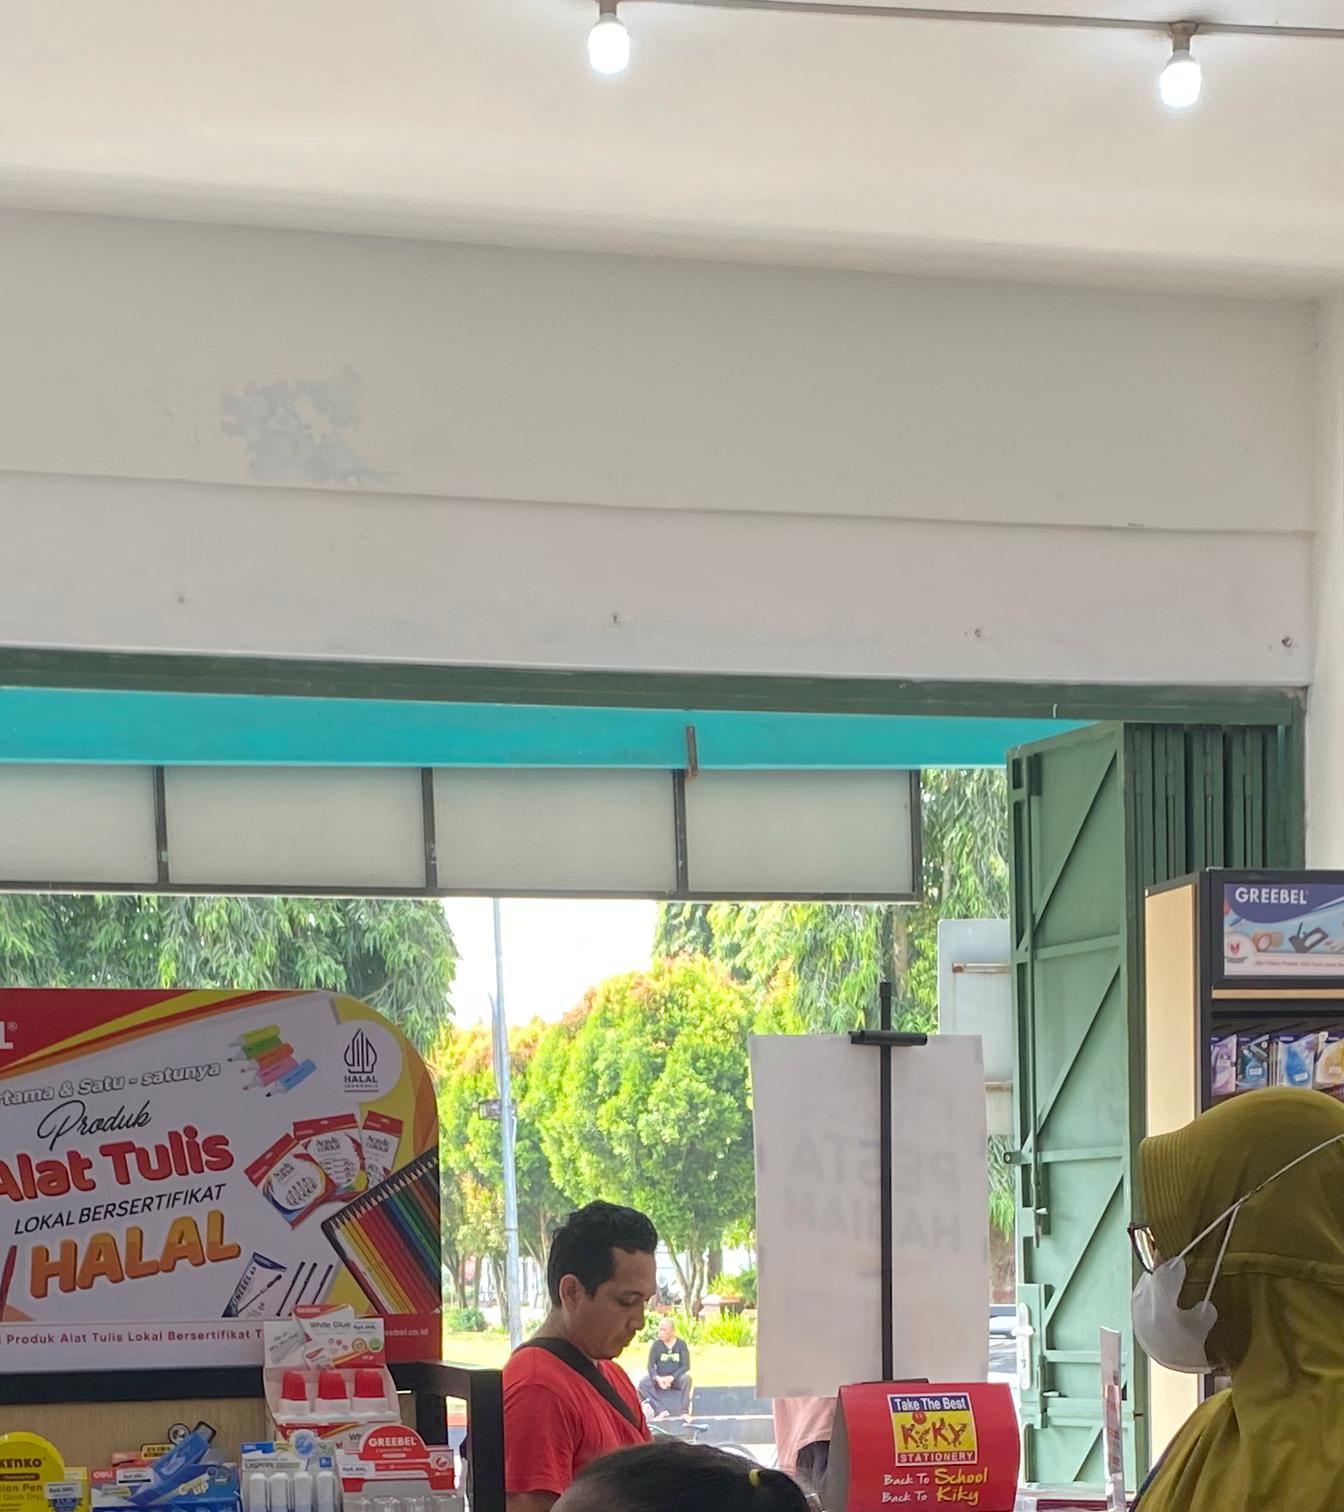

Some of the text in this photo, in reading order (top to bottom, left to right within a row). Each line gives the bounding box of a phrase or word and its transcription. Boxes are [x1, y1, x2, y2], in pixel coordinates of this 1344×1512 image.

[1235, 887, 1308, 905] GREEBEL
[58, 1080, 75, 1098] &
[77, 1076, 126, 1096] Satu
[141, 1061, 221, 1086] satunya
[344, 1075, 379, 1084] HALAL
[37, 1099, 152, 1152] Produk
[99, 1125, 235, 1186] Tulis
[13, 1182, 227, 1236] LOKAL BERSERTIFIKAT
[29, 1209, 242, 1300] HALAL
[6, 1332, 55, 1345] Produk
[59, 1332, 87, 1344] Alat
[91, 1331, 124, 1343] Tulis
[127, 1331, 163, 1343] Lokal
[168, 1328, 250, 1342] Bersertifikat
[894, 1396, 967, 1411] Take The Best
[368, 1435, 419, 1449] GREEBEL
[899, 1451, 974, 1463] STATIONERY
[884, 1466, 989, 1486] Back To School
[22, 1483, 43, 1493] Pen
[881, 1486, 980, 1506] Back To Kiky
